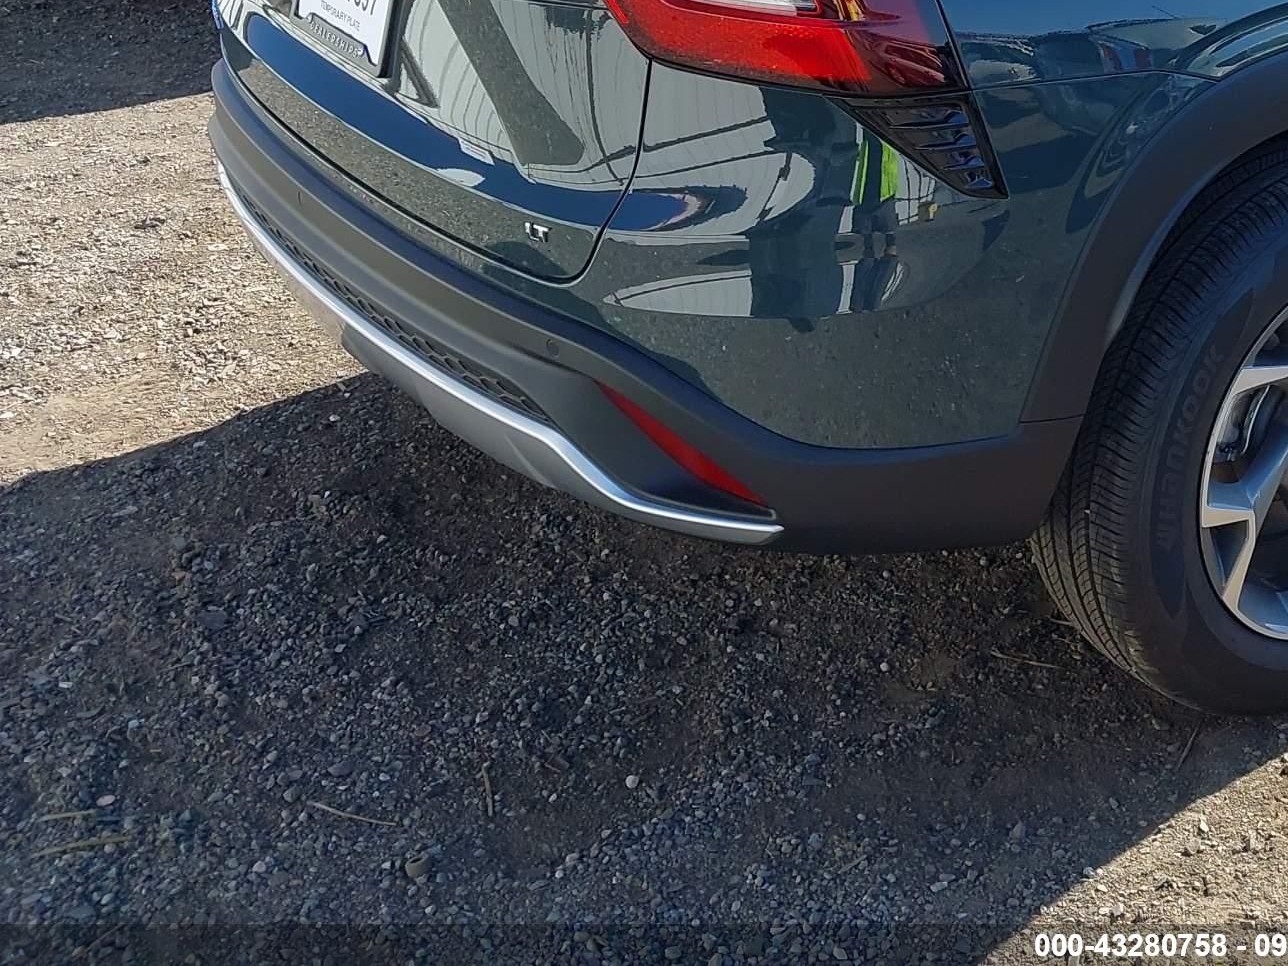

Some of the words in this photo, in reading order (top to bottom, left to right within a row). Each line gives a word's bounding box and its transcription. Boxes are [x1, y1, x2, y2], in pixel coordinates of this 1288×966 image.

[320, 0, 350, 23] TEMPORARY
[347, 17, 361, 33] PLATE
[310, 20, 359, 58] DEALERSHIPS
[524, 222, 551, 243] LT
